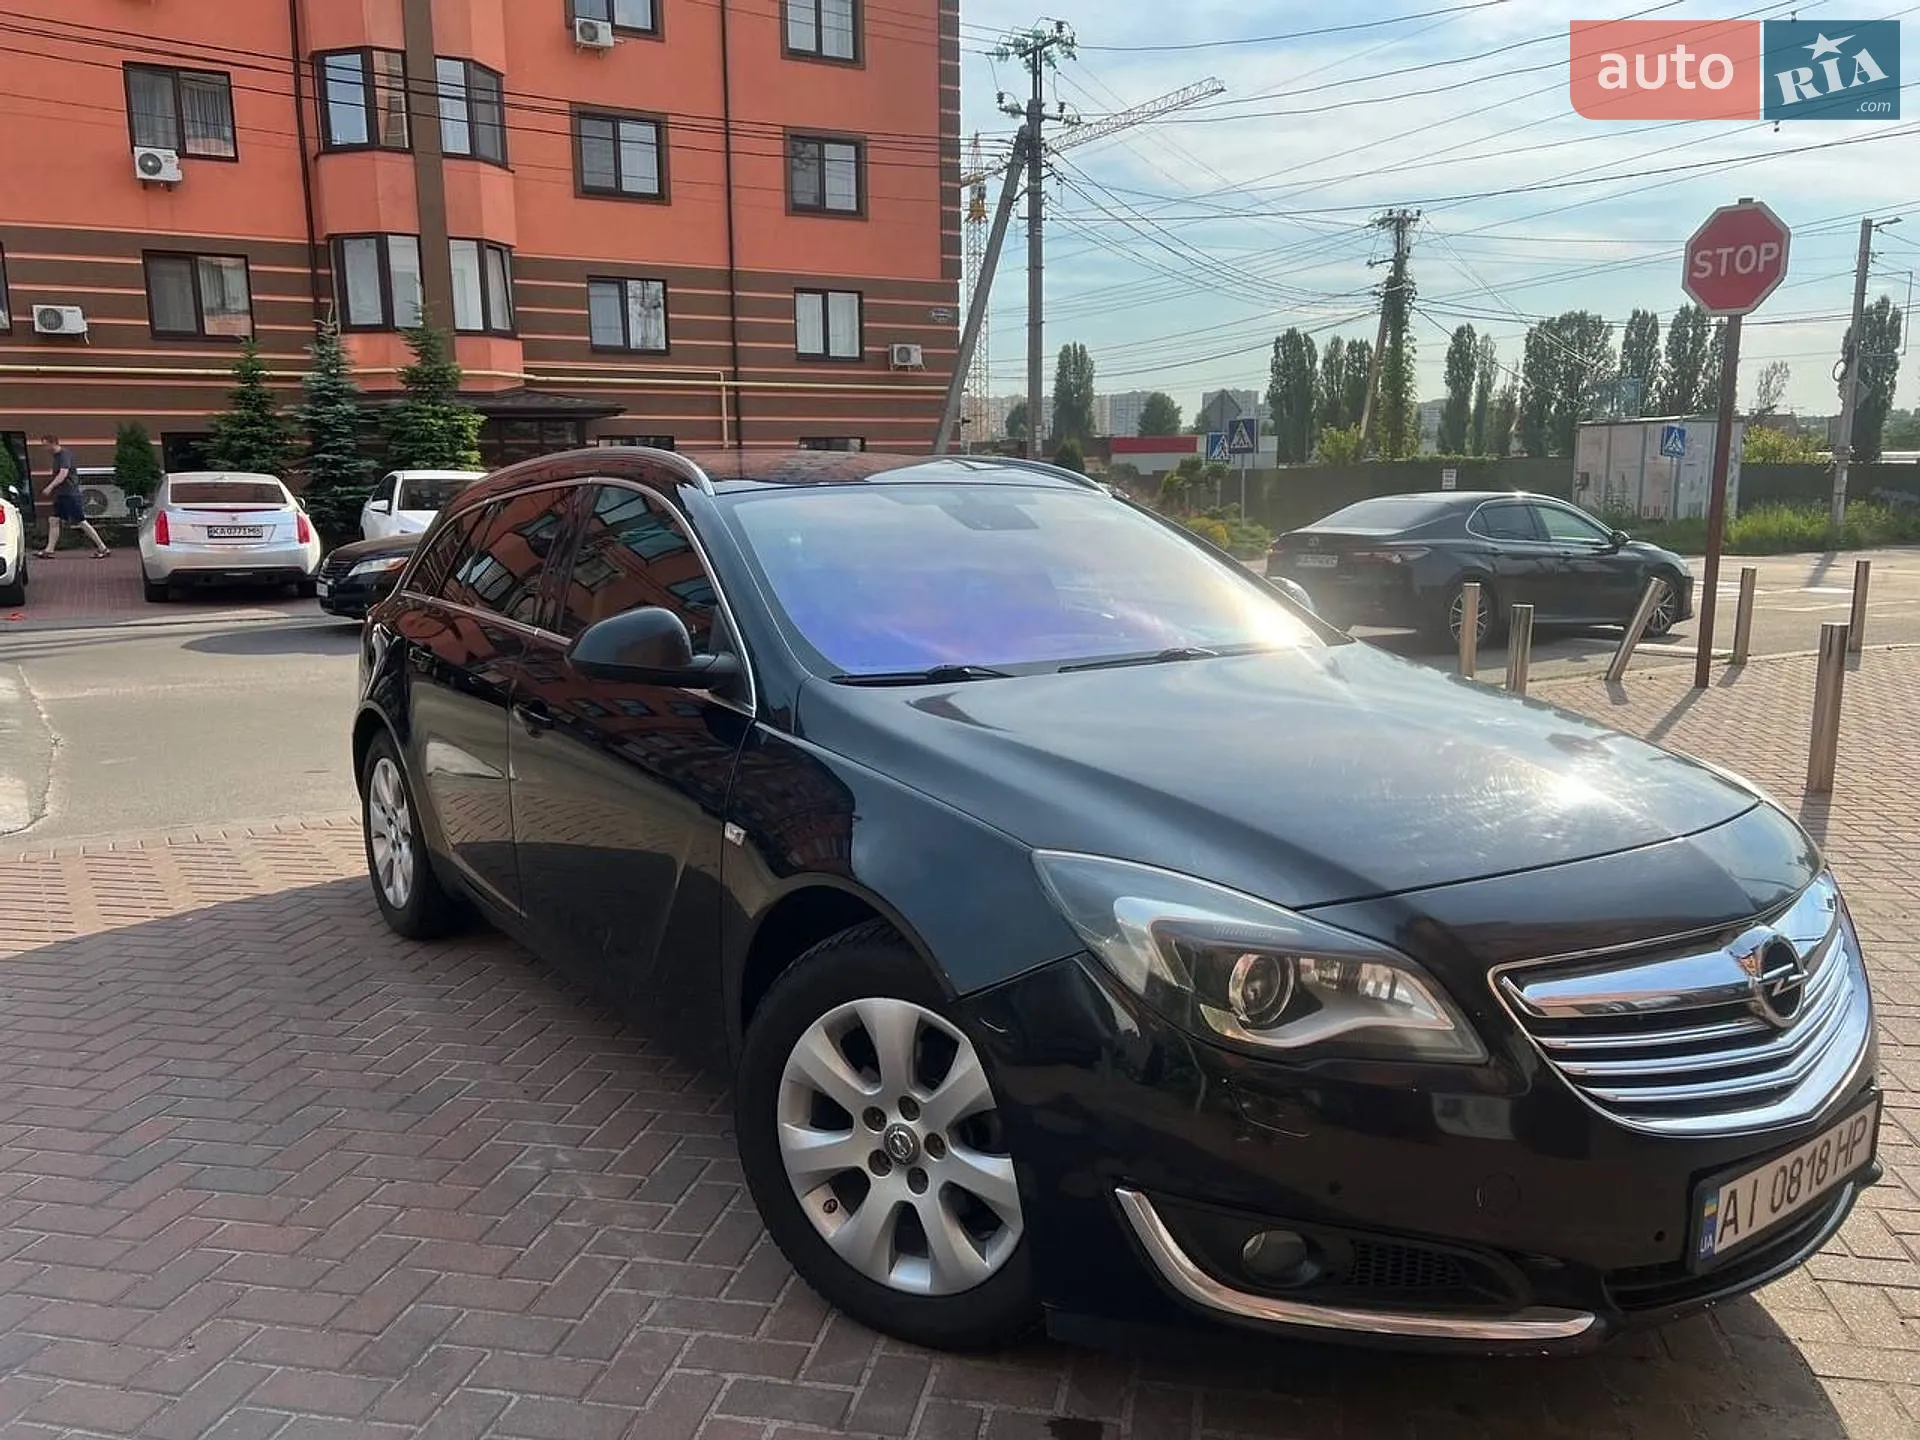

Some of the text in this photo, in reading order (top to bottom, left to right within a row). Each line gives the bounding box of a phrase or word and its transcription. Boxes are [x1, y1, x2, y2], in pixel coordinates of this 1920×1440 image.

[1691, 242, 1780, 279] STOP
[1717, 1114, 1868, 1245] AI 0818 HP
